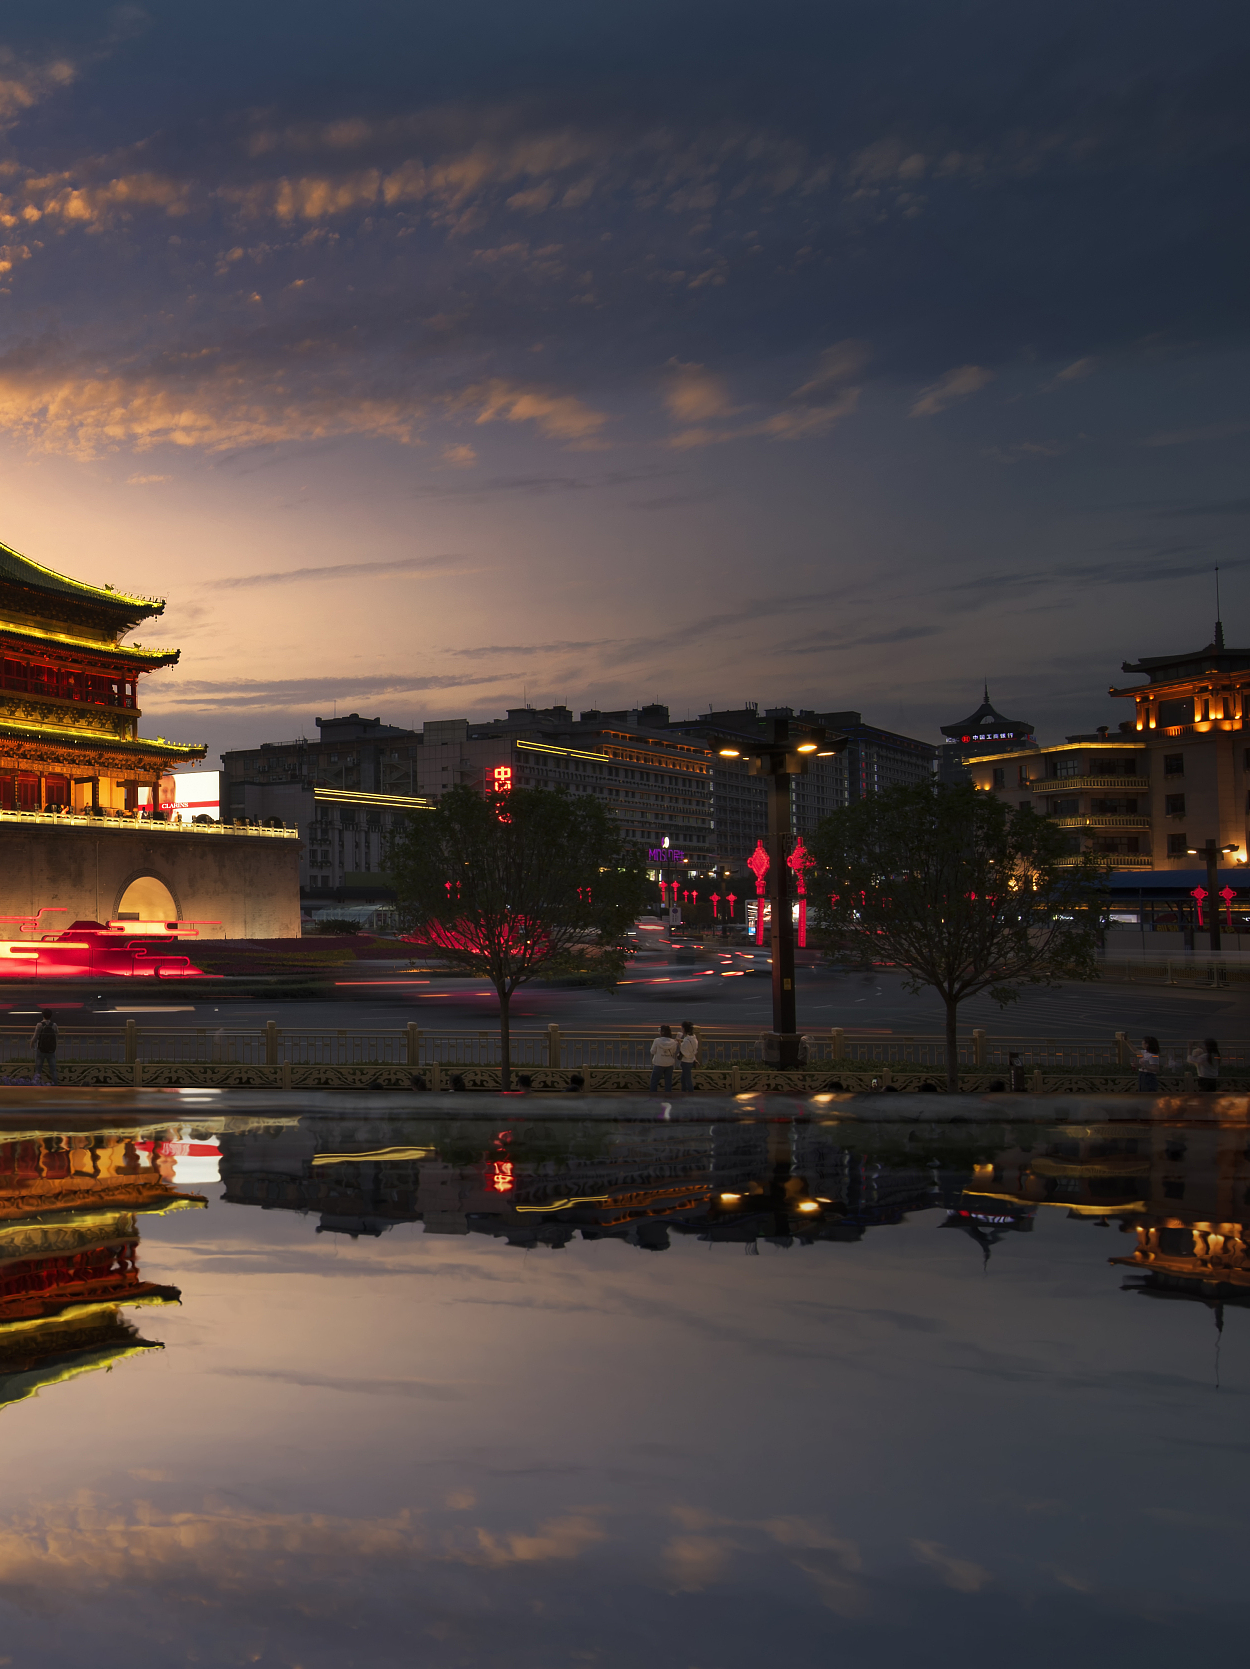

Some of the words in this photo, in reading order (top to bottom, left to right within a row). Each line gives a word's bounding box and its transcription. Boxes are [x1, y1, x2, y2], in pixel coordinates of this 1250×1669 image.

[972, 732, 1014, 741] 中国工商银行
